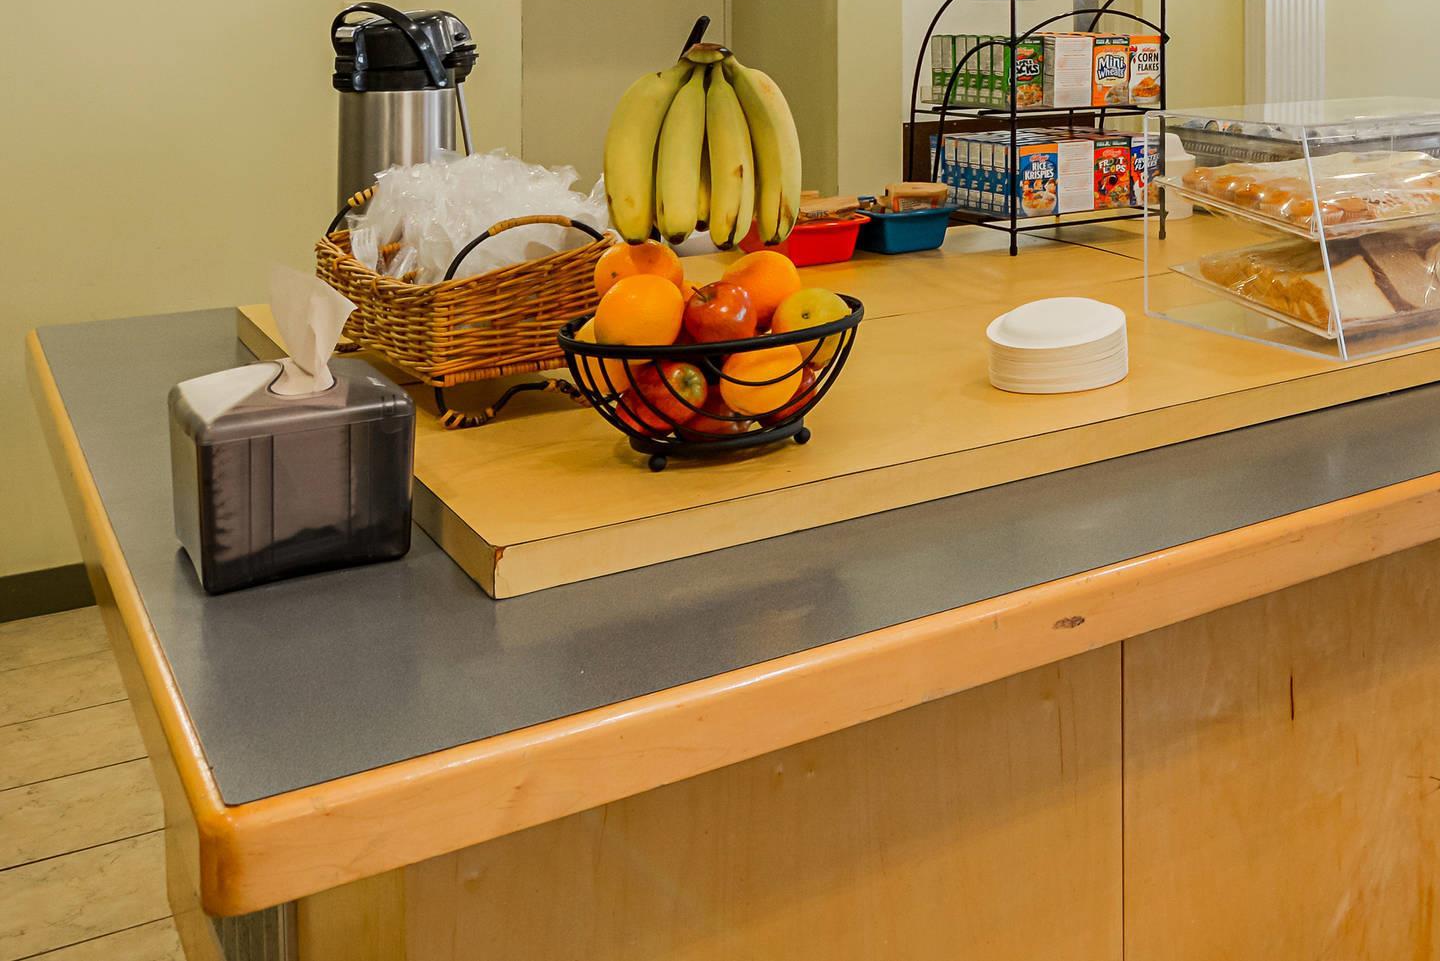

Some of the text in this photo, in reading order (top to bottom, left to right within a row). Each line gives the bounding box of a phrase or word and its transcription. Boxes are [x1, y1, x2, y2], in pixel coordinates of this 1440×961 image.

[1098, 55, 1126, 71] Mini
[1137, 52, 1159, 63] CORN
[1137, 63, 1160, 72] FLAKES
[1032, 162, 1047, 171] RICE
[1024, 169, 1054, 180] KRISPIES
